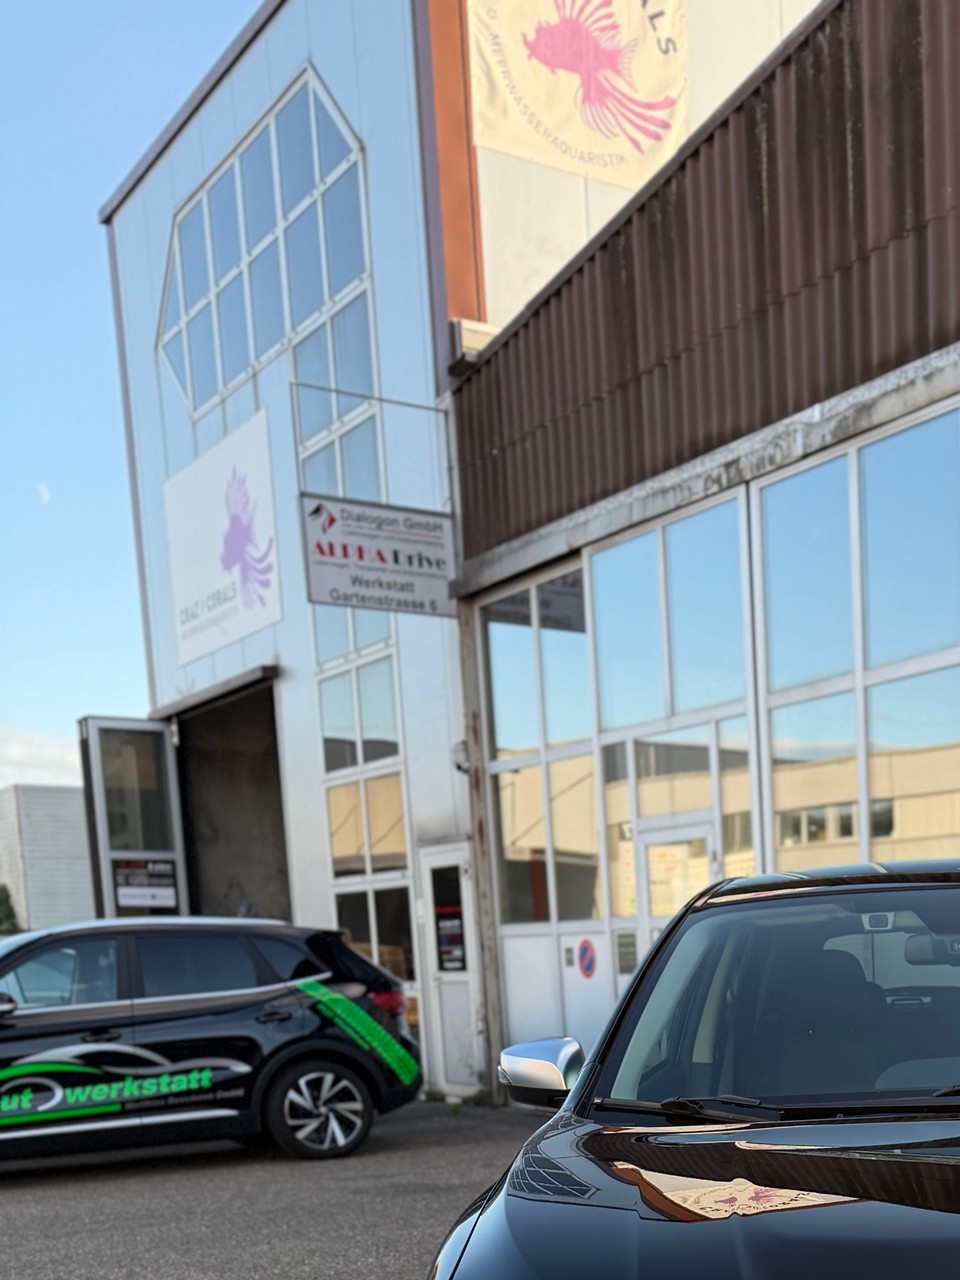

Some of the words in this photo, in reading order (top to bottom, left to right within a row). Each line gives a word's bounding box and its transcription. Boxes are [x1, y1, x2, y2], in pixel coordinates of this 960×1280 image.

[403, 517, 444, 532] GmbH
[350, 574, 416, 593] Werkstatt
[329, 588, 425, 610] Gartenstrasse
